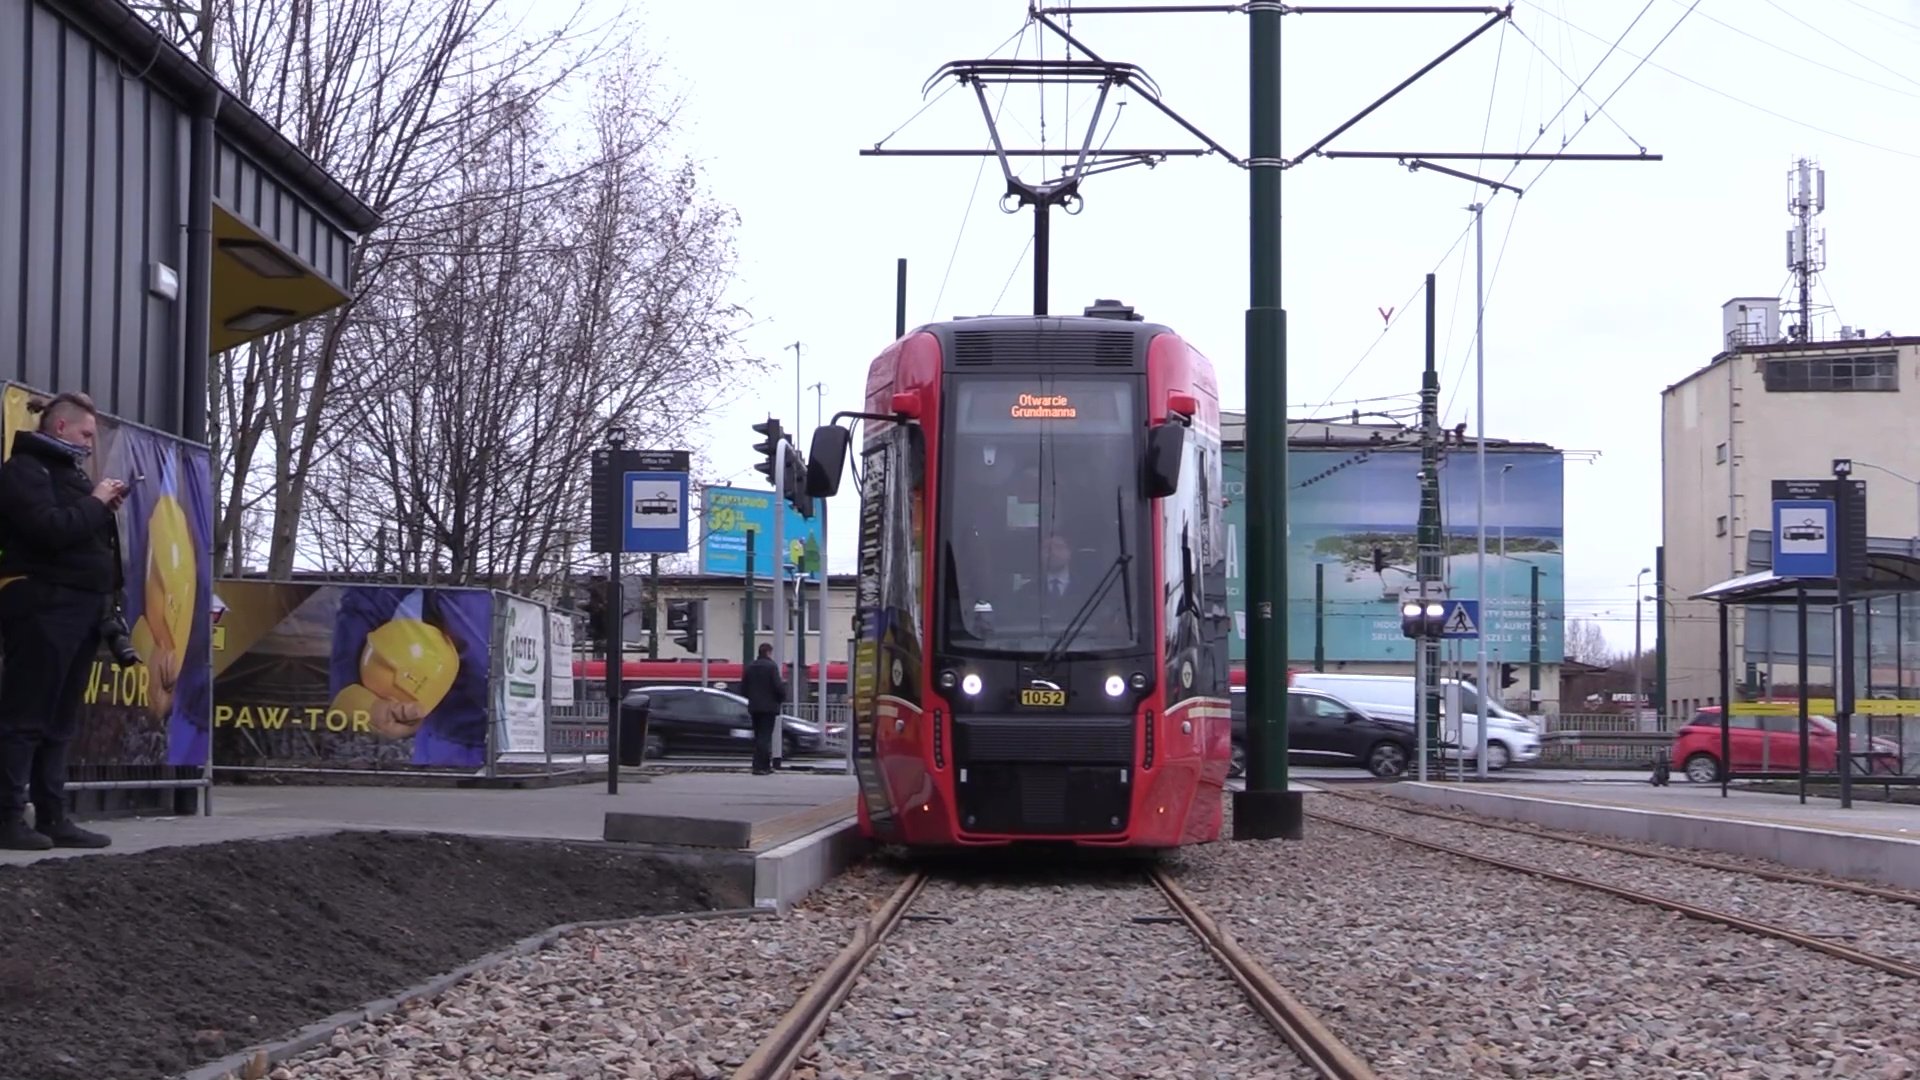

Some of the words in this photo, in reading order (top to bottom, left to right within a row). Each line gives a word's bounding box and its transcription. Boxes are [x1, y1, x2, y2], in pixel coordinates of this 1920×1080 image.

[1019, 394, 1067, 406] Otwarcie
[1011, 405, 1076, 417] Grundmanna
[708, 506, 735, 531] 39
[84, 661, 149, 707] W-TOR
[1023, 691, 1062, 704] 1052
[214, 705, 371, 732] PAW-TOR
